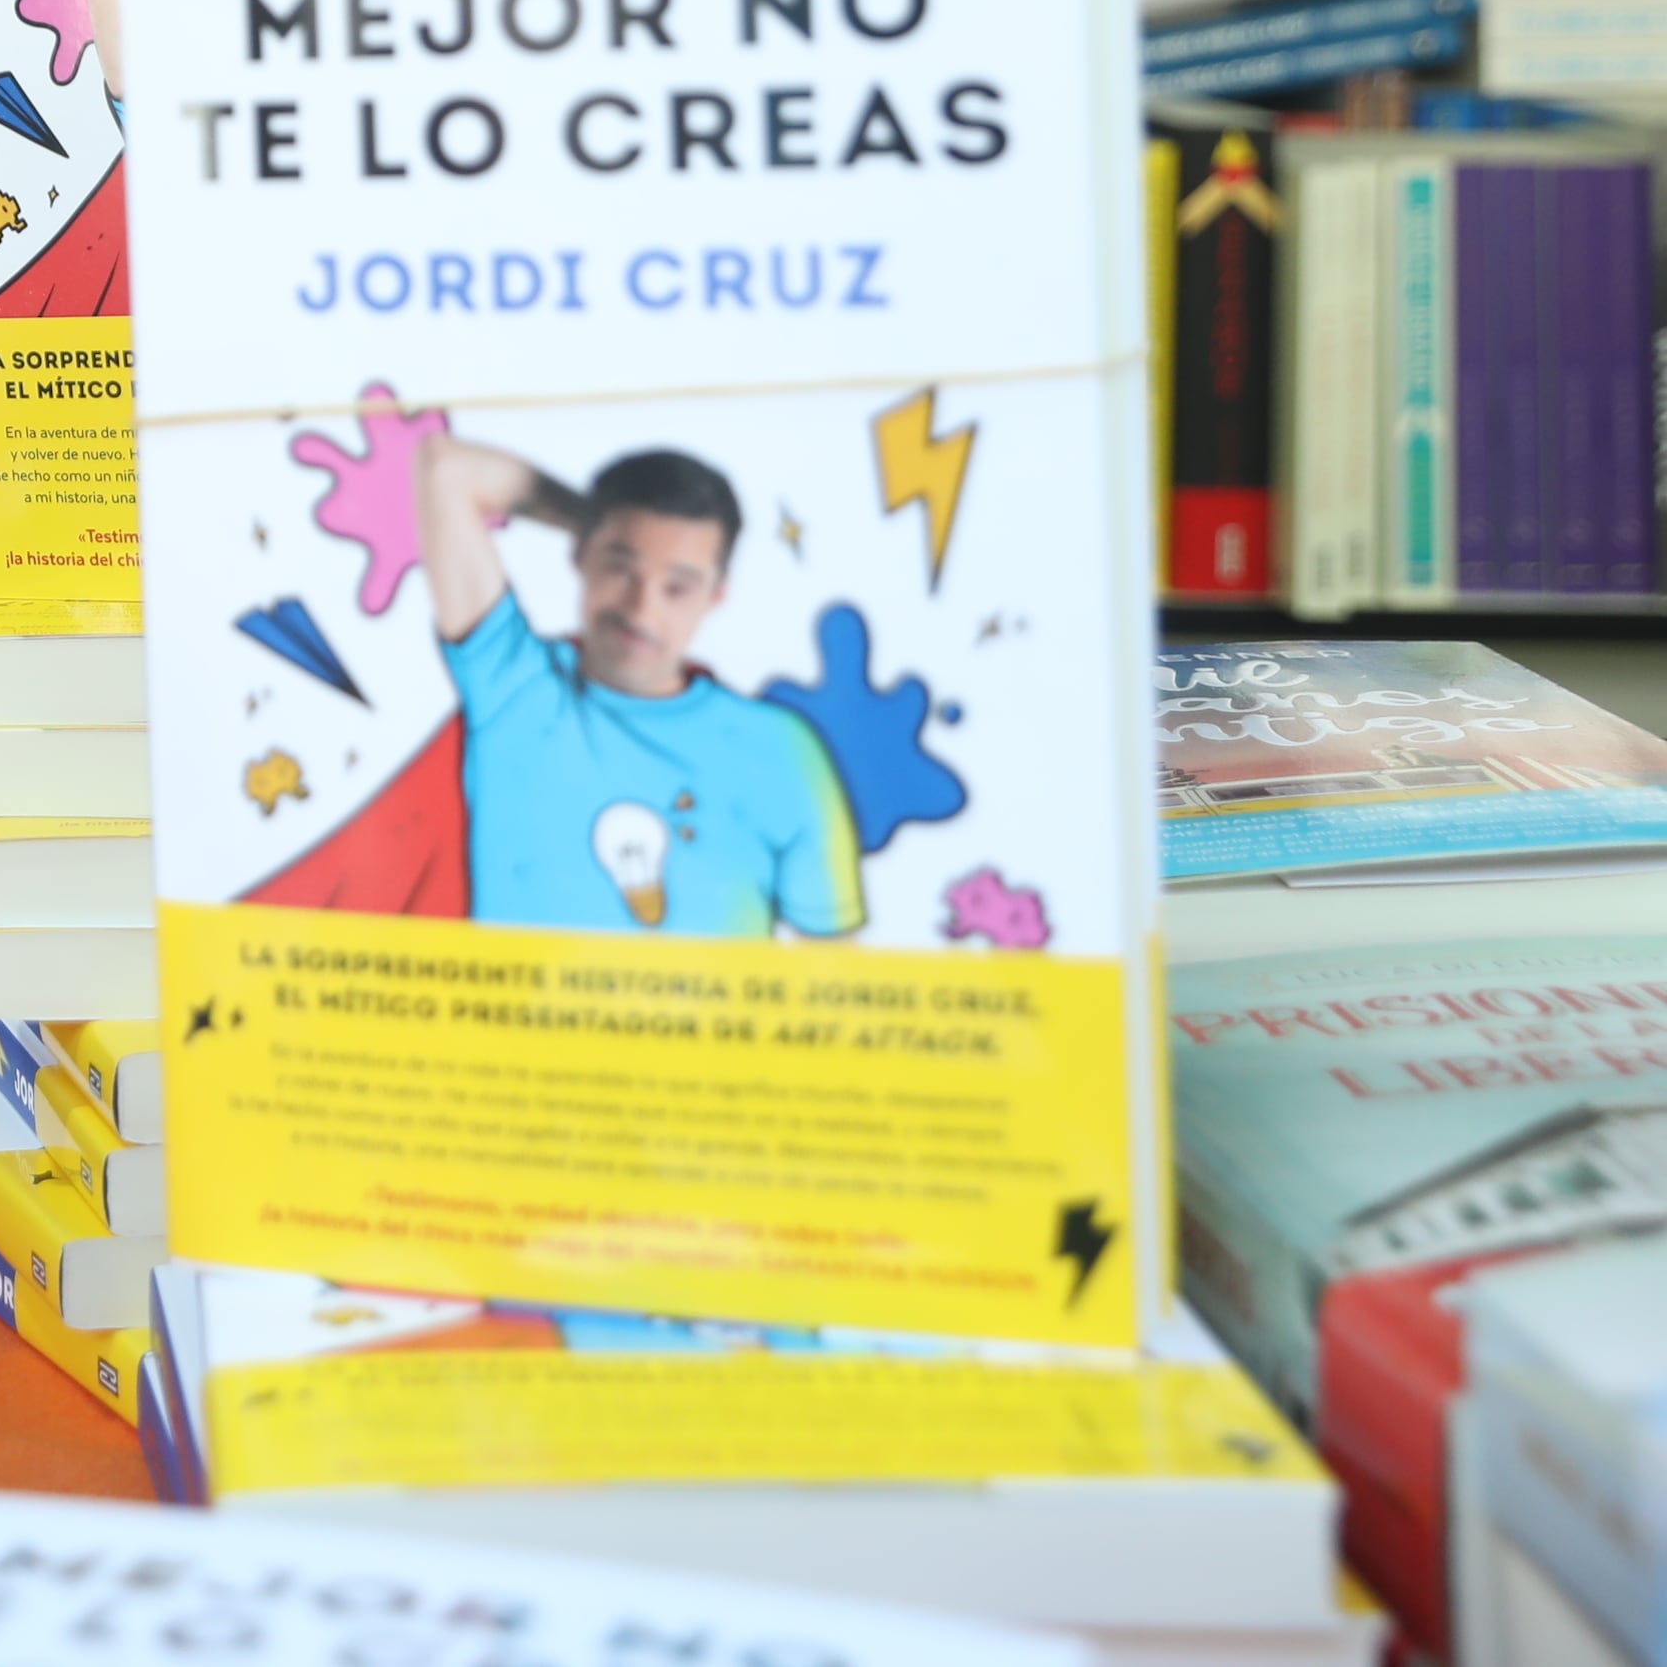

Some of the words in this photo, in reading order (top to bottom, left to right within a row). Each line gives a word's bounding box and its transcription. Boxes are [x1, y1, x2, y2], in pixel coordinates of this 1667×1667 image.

[179, 101, 303, 182] TE
[359, 94, 507, 179] LO
[564, 79, 1011, 173] CREAS
[295, 250, 589, 314] JORDI
[624, 243, 893, 311] CRUZ
[5, 381, 29, 399] EL
[37, 376, 122, 399] MÍTICO
[5, 426, 22, 439] En
[26, 426, 37, 439] la
[40, 427, 97, 440] aventura
[101, 426, 117, 439] de
[10, 450, 18, 463] y
[21, 448, 59, 461] volver
[62, 448, 78, 461] de
[82, 449, 126, 461] nuevo.
[12, 469, 51, 483] hecho
[54, 471, 91, 483] como
[95, 471, 111, 483] un
[24, 493, 32, 504] a
[36, 491, 52, 504] mi
[55, 490, 109, 506] historia,
[111, 493, 137, 504] una
[6, 551, 23, 569] ¡la
[27, 550, 86, 567] historia
[89, 551, 113, 567] del
[240, 943, 275, 970] LA
[287, 945, 547, 990] SORPRENDENTE
[559, 964, 728, 1002] HISTORIA
[744, 977, 788, 1004] DE
[804, 980, 919, 1013] JORDI
[275, 984, 307, 1010] EL
[319, 985, 437, 1021] MÍTICO
[452, 996, 701, 1038] PRESENTADOR
[713, 1015, 757, 1042] DE
[774, 1021, 844, 1049] ART
